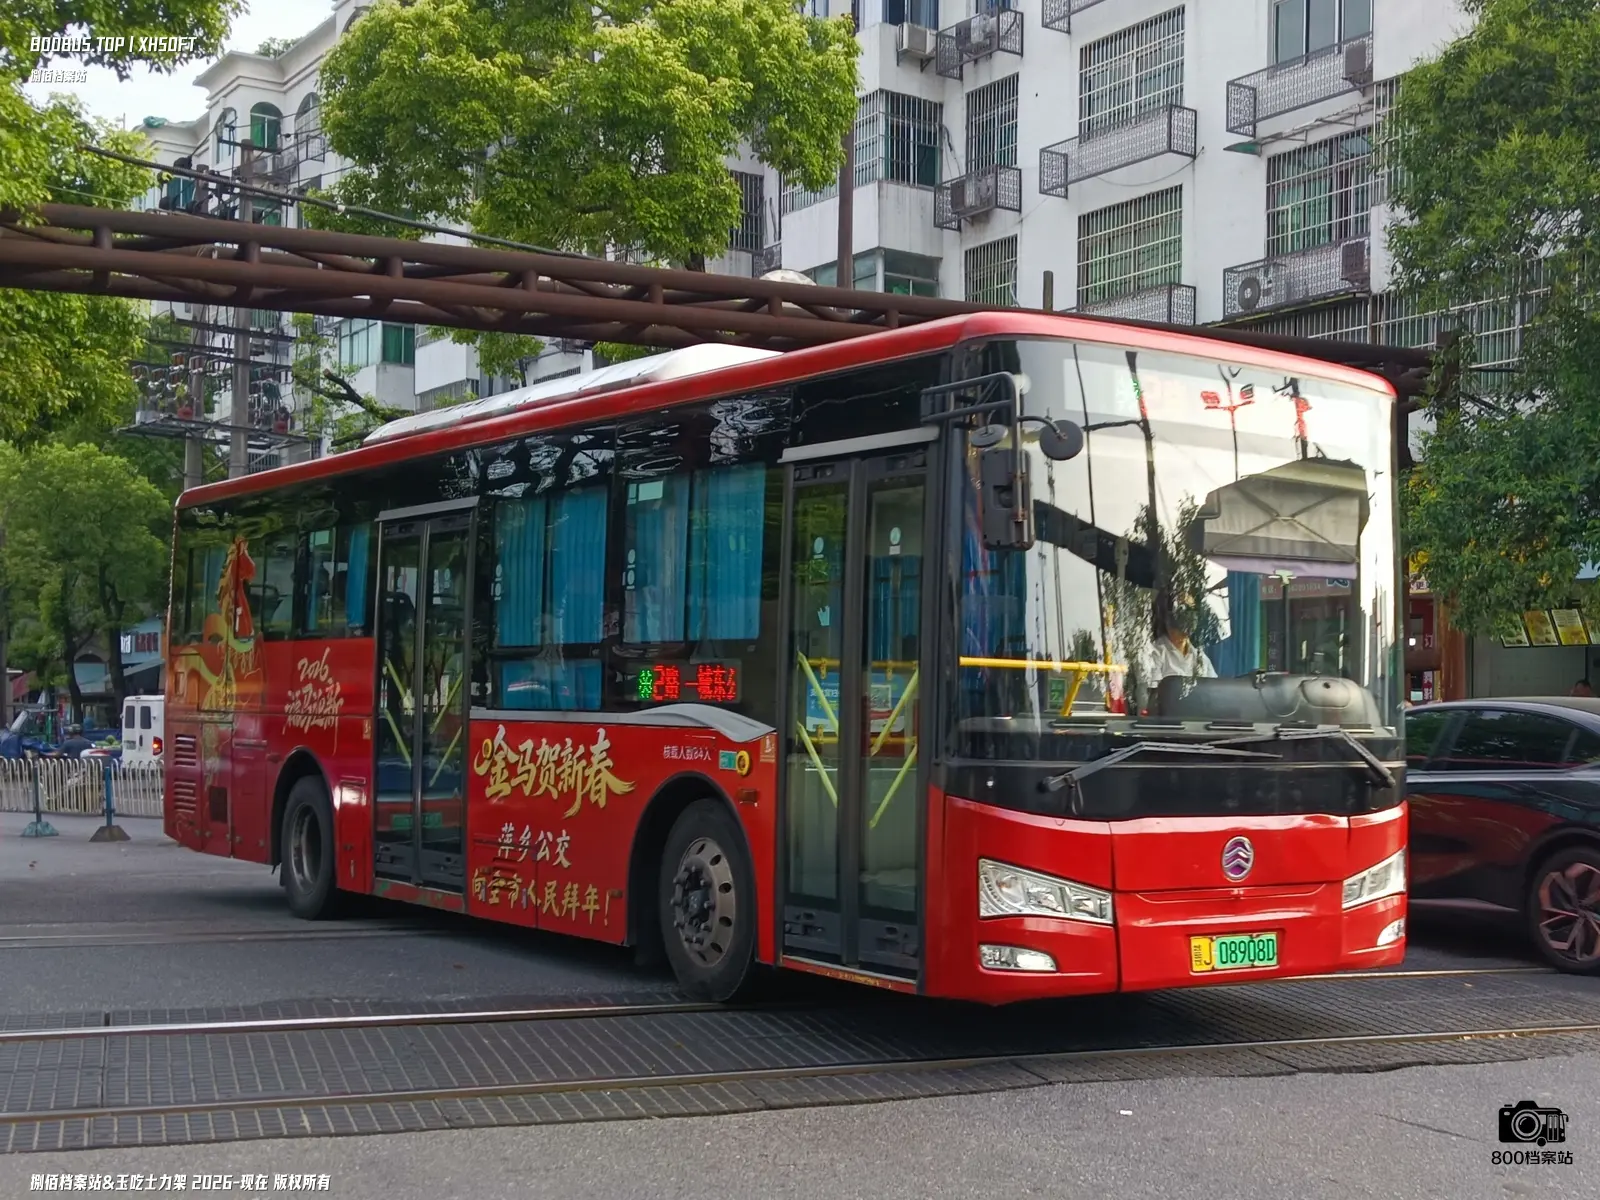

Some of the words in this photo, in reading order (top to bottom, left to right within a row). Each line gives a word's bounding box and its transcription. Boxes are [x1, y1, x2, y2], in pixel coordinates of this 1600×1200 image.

[298, 646, 331, 682] 2026
[473, 723, 637, 820] 金马贺新春
[498, 822, 572, 869] 萍乡公交
